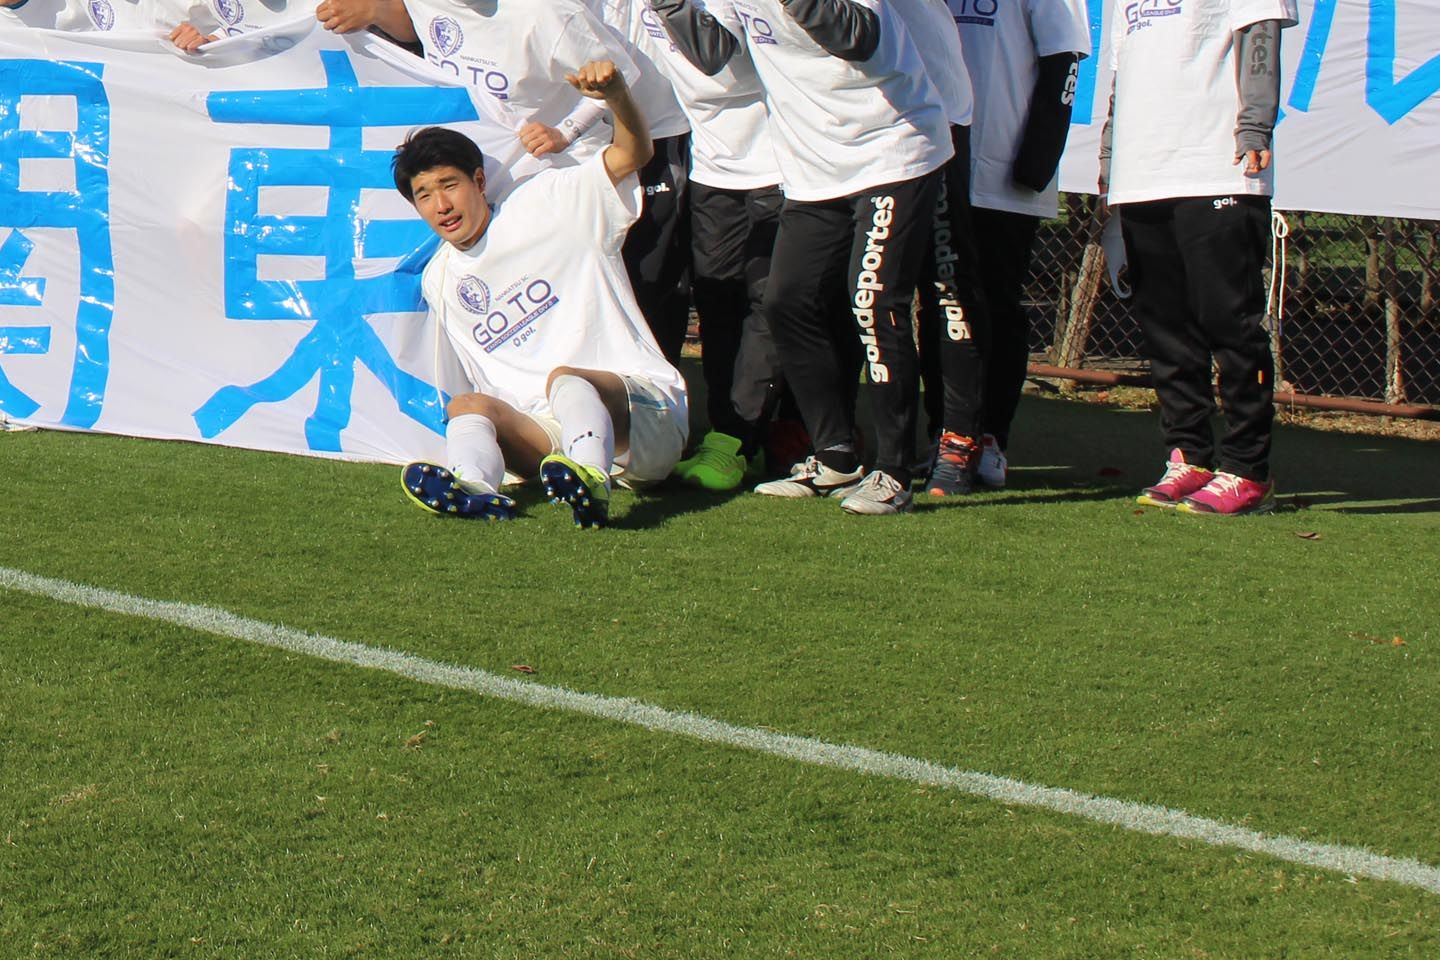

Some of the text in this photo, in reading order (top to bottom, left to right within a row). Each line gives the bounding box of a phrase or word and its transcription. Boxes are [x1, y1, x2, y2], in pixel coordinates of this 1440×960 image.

[467, 66, 509, 92] TO
[1213, 196, 1238, 209] gol.
[472, 279, 551, 346] GO TO
[852, 195, 896, 384] gol.deportes
